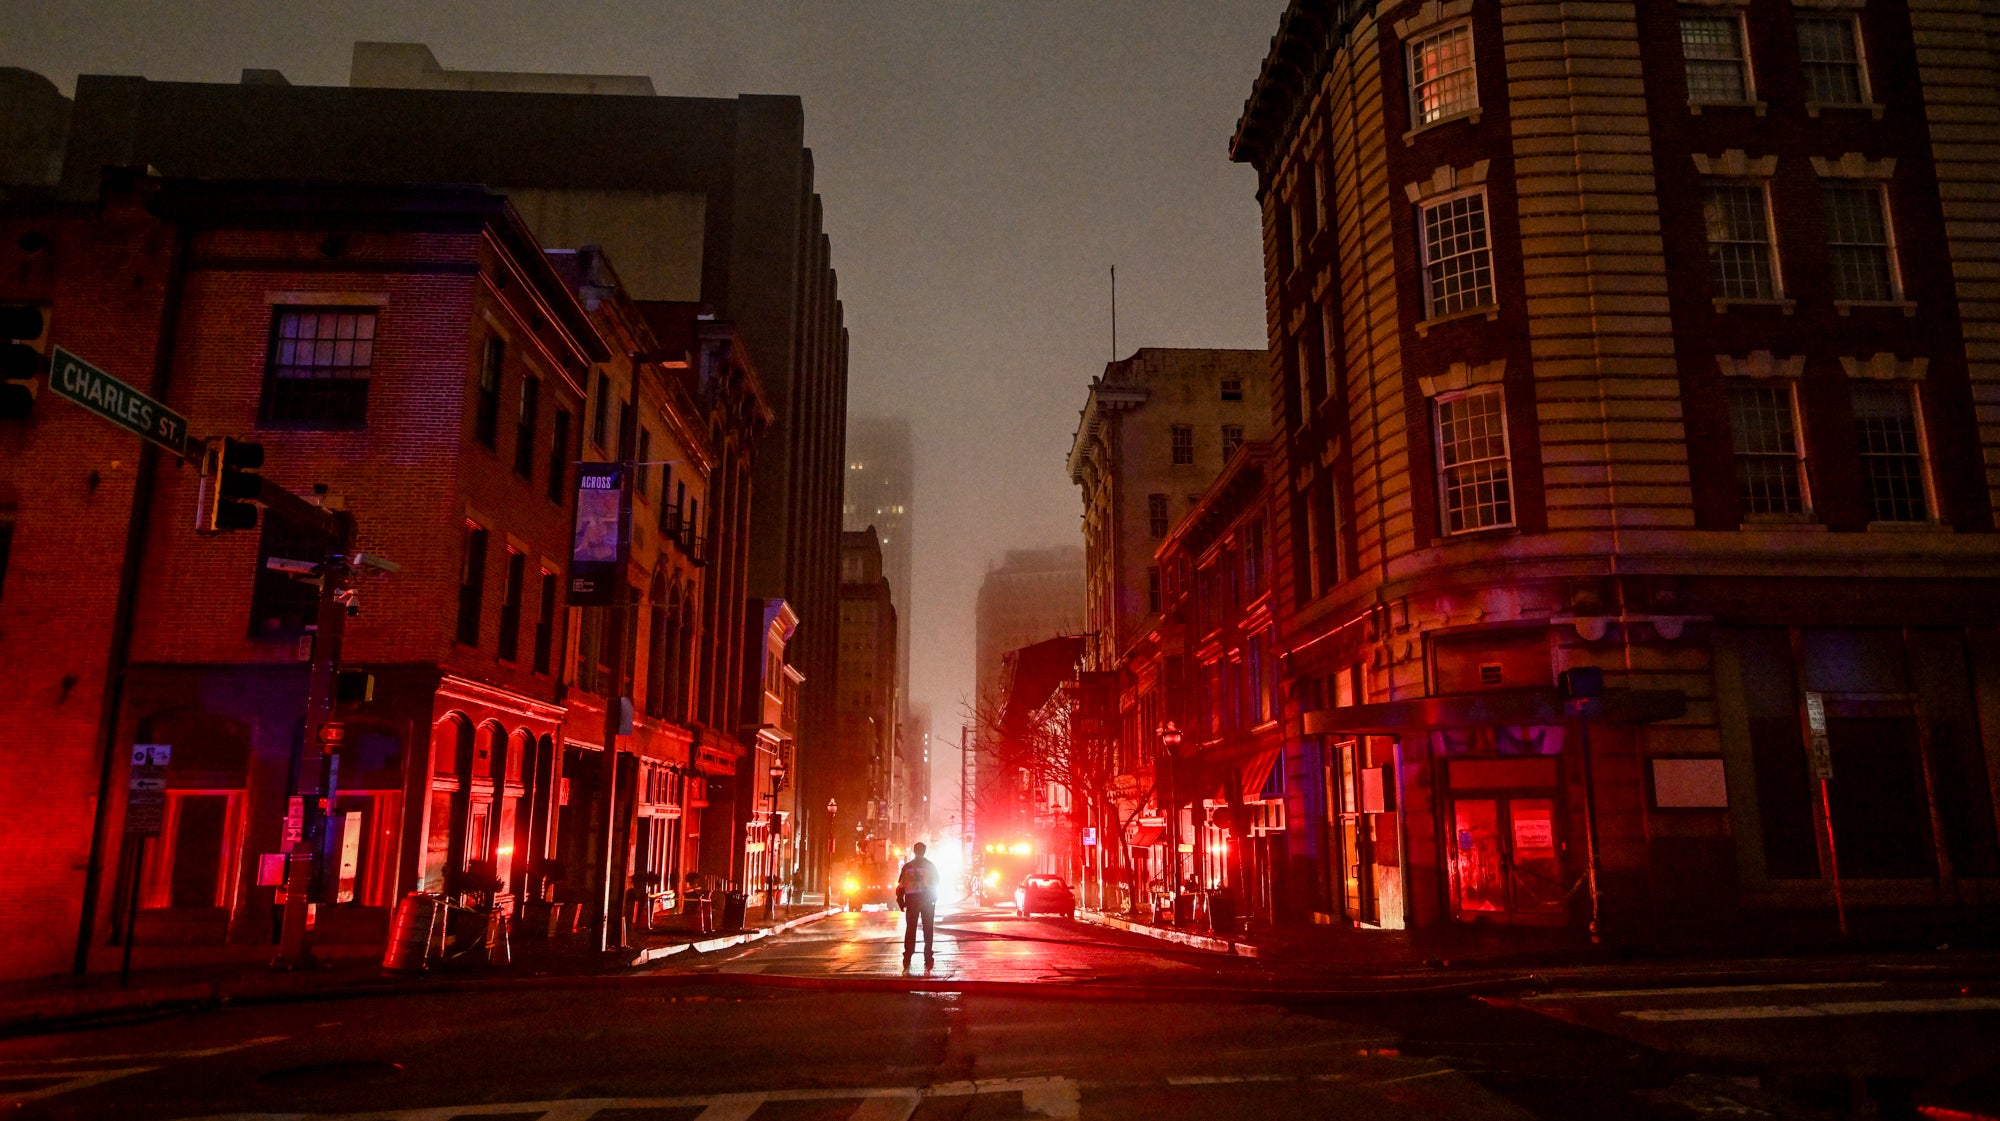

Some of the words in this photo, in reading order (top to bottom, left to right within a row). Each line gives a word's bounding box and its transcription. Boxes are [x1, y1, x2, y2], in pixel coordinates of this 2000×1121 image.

[63, 363, 153, 430] CHARLES
[159, 416, 179, 443] ST.
[581, 475, 612, 489] ACROSS
